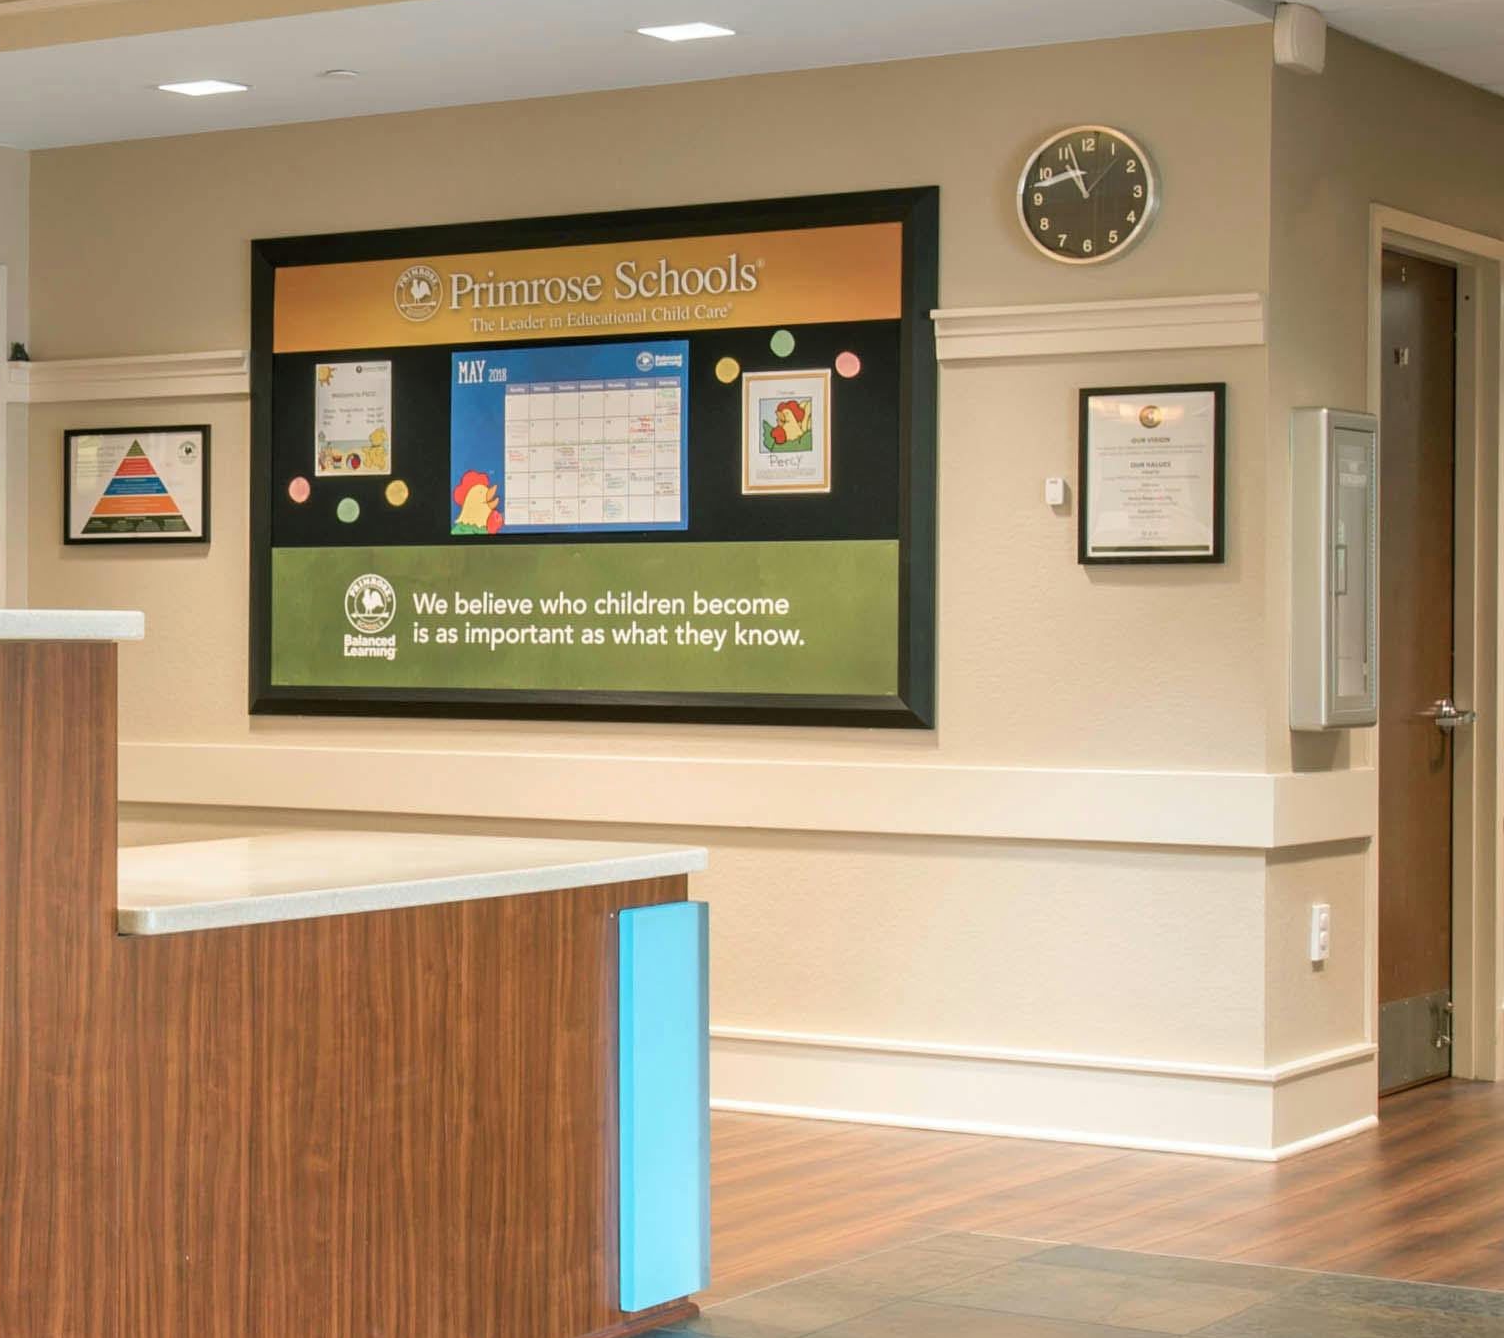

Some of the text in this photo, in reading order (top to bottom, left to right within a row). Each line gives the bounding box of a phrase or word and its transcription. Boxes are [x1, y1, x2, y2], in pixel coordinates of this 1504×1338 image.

[1082, 138, 1095, 152] 12
[1111, 142, 1115, 156] 1
[1058, 147, 1069, 160] 11
[1126, 159, 1136, 173] 2
[1039, 167, 1053, 180] 10
[1133, 185, 1143, 198] 3
[1034, 192, 1043, 206] 9
[1126, 210, 1136, 223] 4
[1040, 218, 1049, 231] 8
[1058, 234, 1067, 247] 7
[1109, 230, 1118, 244] 5
[1083, 239, 1092, 252] 6
[399, 267, 439, 289] PRIMROSE
[449, 270, 602, 309] Primrose
[471, 316, 496, 332] The
[500, 314, 545, 331] Leader
[549, 314, 562, 328] in
[567, 308, 647, 327] Educational
[651, 305, 690, 322] Child
[458, 360, 507, 384] MAY 2018
[413, 590, 790, 615] We believe who children become
[344, 633, 396, 647] Balanced
[412, 620, 806, 652] is as important as what they know.
[344, 646, 397, 660] Learning
